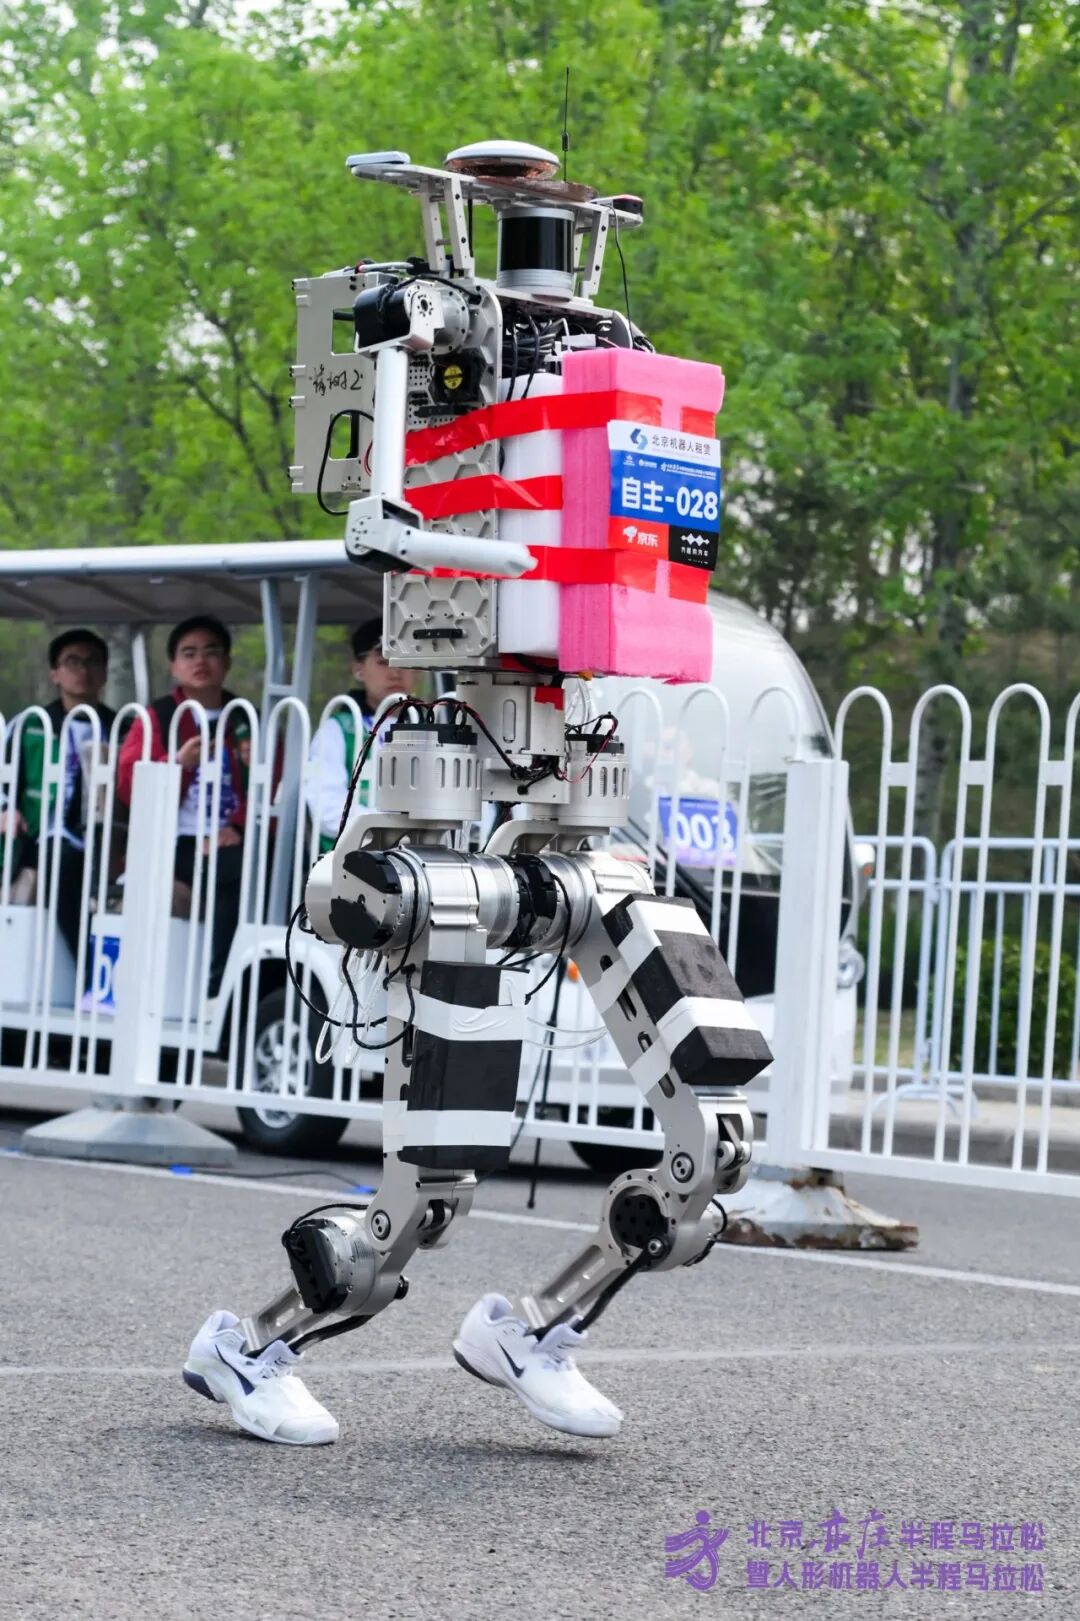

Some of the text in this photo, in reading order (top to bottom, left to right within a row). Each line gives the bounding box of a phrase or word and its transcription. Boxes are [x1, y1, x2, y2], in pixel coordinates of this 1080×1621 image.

[652, 435, 712, 456] 北京机器人租赁
[622, 477, 718, 521] 自主-028
[637, 531, 659, 548] 京东
